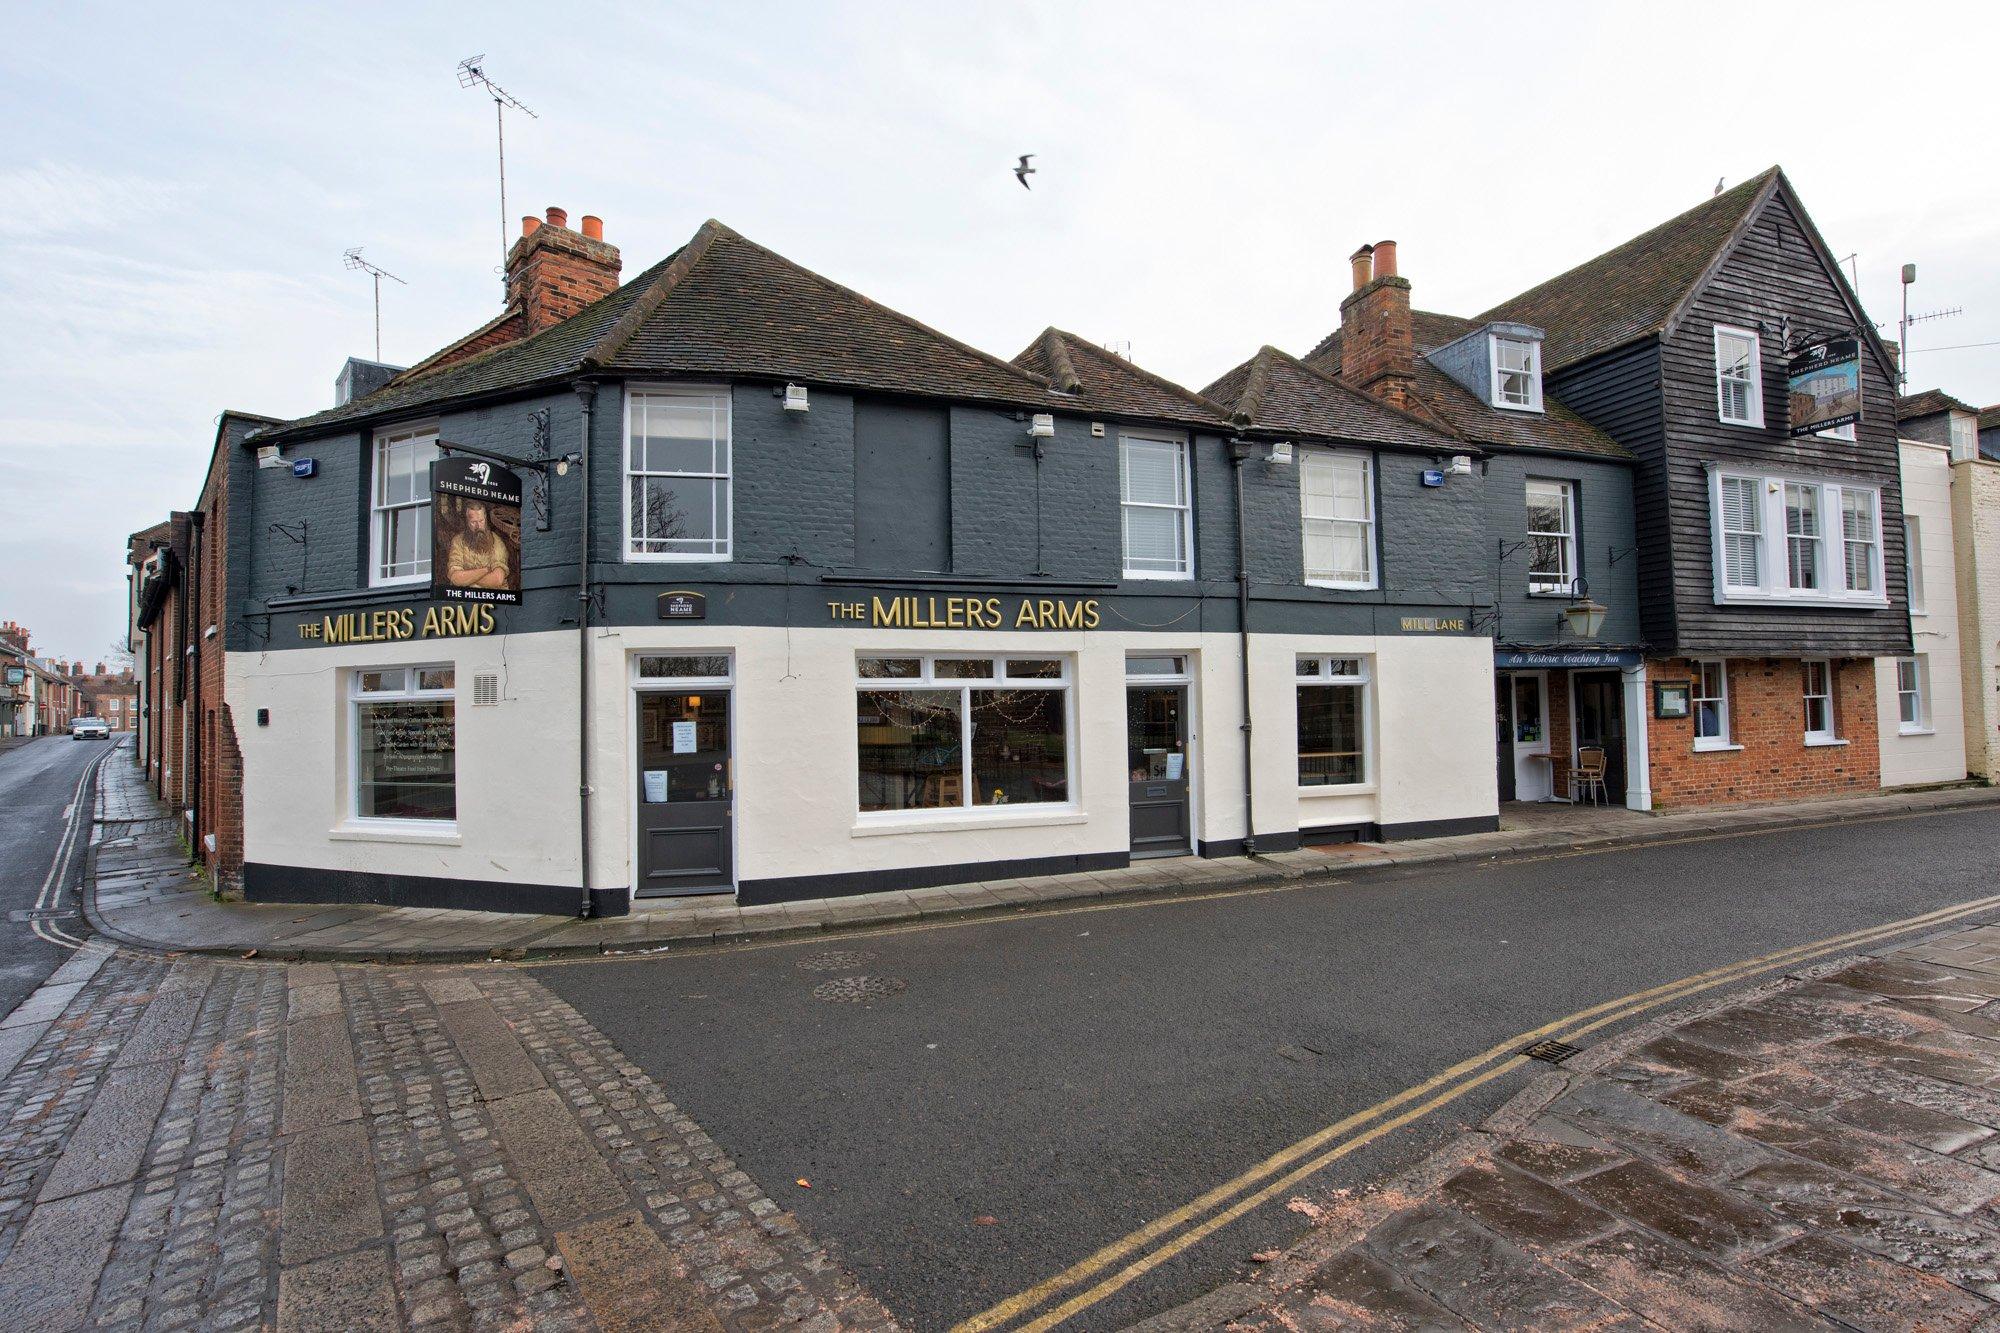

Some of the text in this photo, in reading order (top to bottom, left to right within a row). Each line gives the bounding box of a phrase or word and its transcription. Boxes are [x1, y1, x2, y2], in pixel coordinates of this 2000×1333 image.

[1790, 352, 1855, 375] SHEPHERD NEAME
[1810, 420, 1835, 430] MILLERS
[1836, 415, 1854, 423] ARMS
[440, 480, 520, 503] SHEPHERD NEAME
[446, 589, 516, 602] THE MILLERS ARMS
[828, 596, 1100, 629] THE MILLERS ARMS
[298, 603, 495, 643] THE MILLERS ARMS
[1402, 619, 1465, 631] MILL LANE
[1509, 654, 1619, 664] An Historic Coaching Inn
